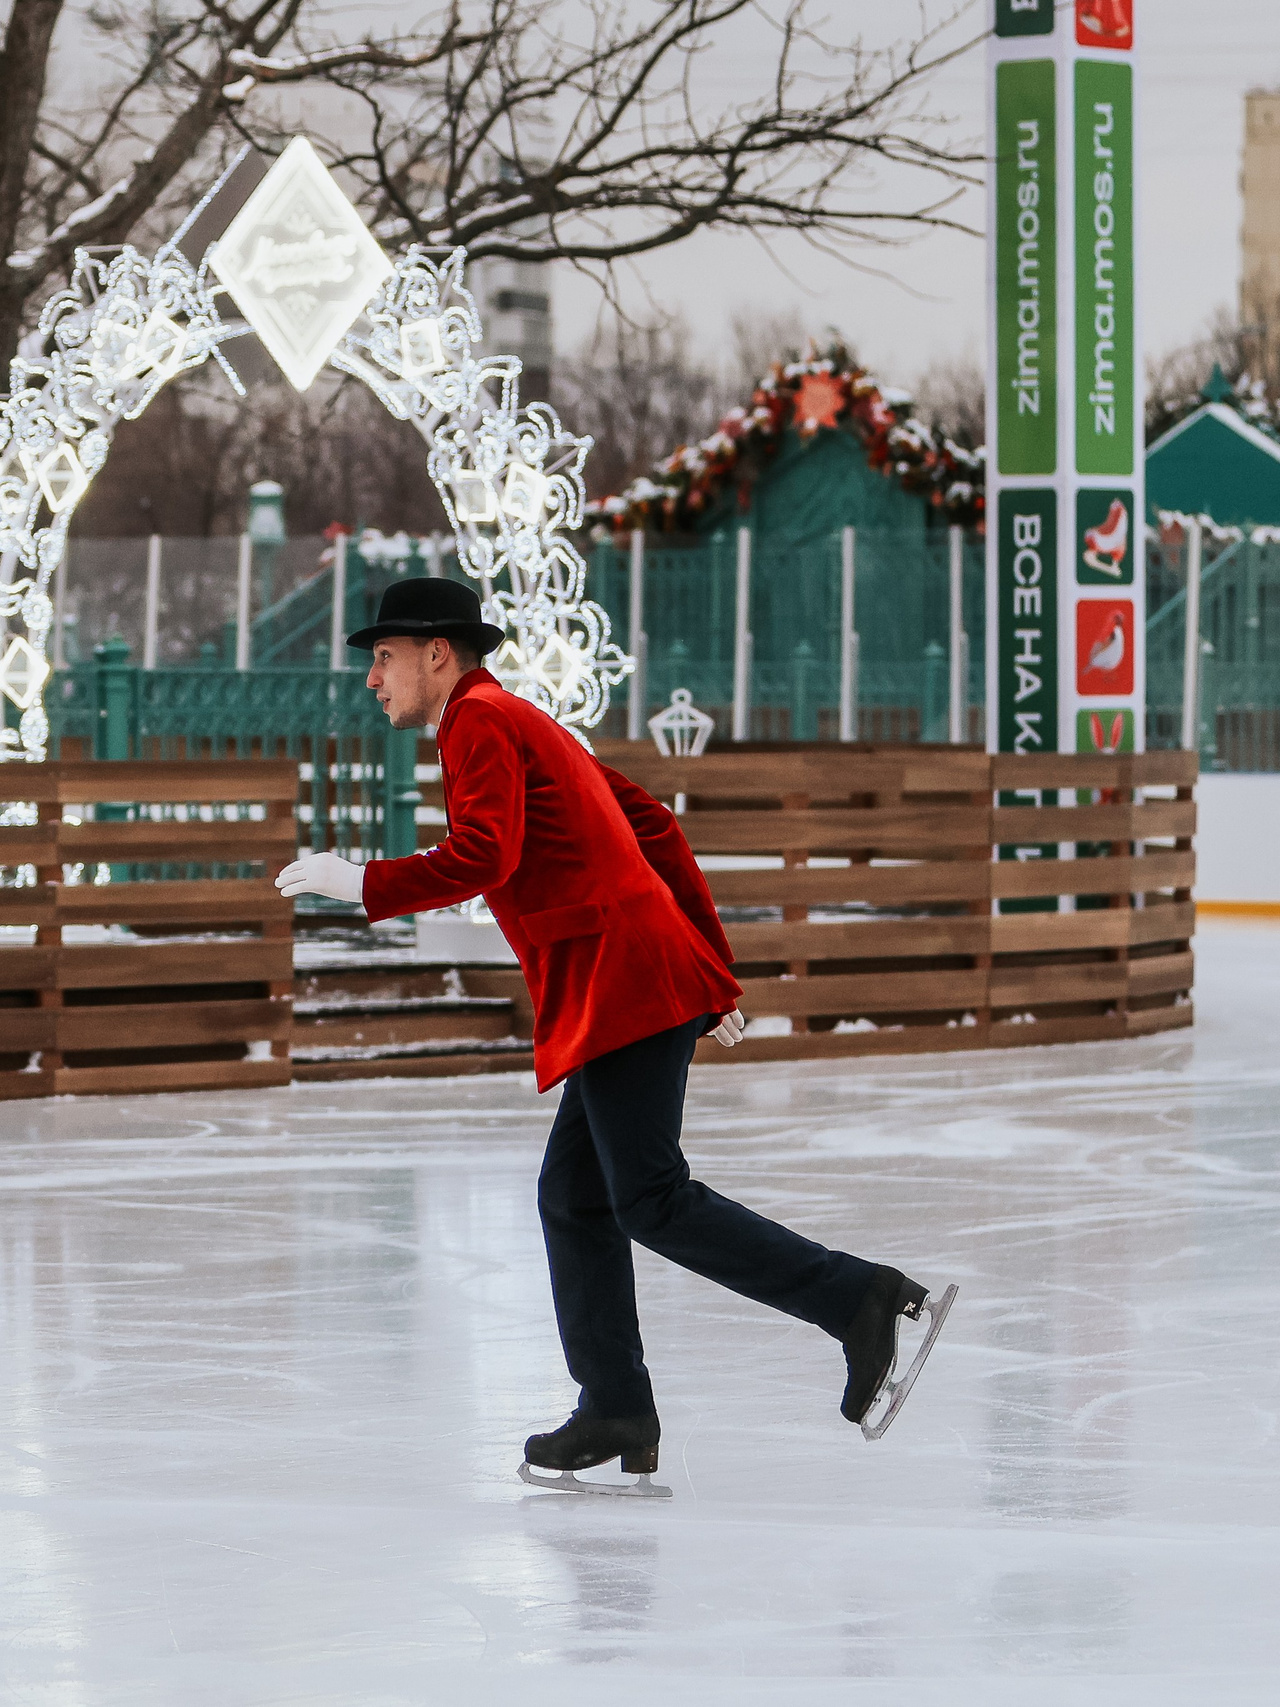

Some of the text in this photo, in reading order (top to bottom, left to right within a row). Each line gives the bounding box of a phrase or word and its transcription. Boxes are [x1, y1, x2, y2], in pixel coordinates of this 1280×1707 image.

[1011, 119, 1040, 417] zima.mos.ru
[1089, 102, 1116, 436] zima.mos.ru
[1013, 513, 1043, 618] ВСЕ
[1014, 628, 1043, 704] НА
